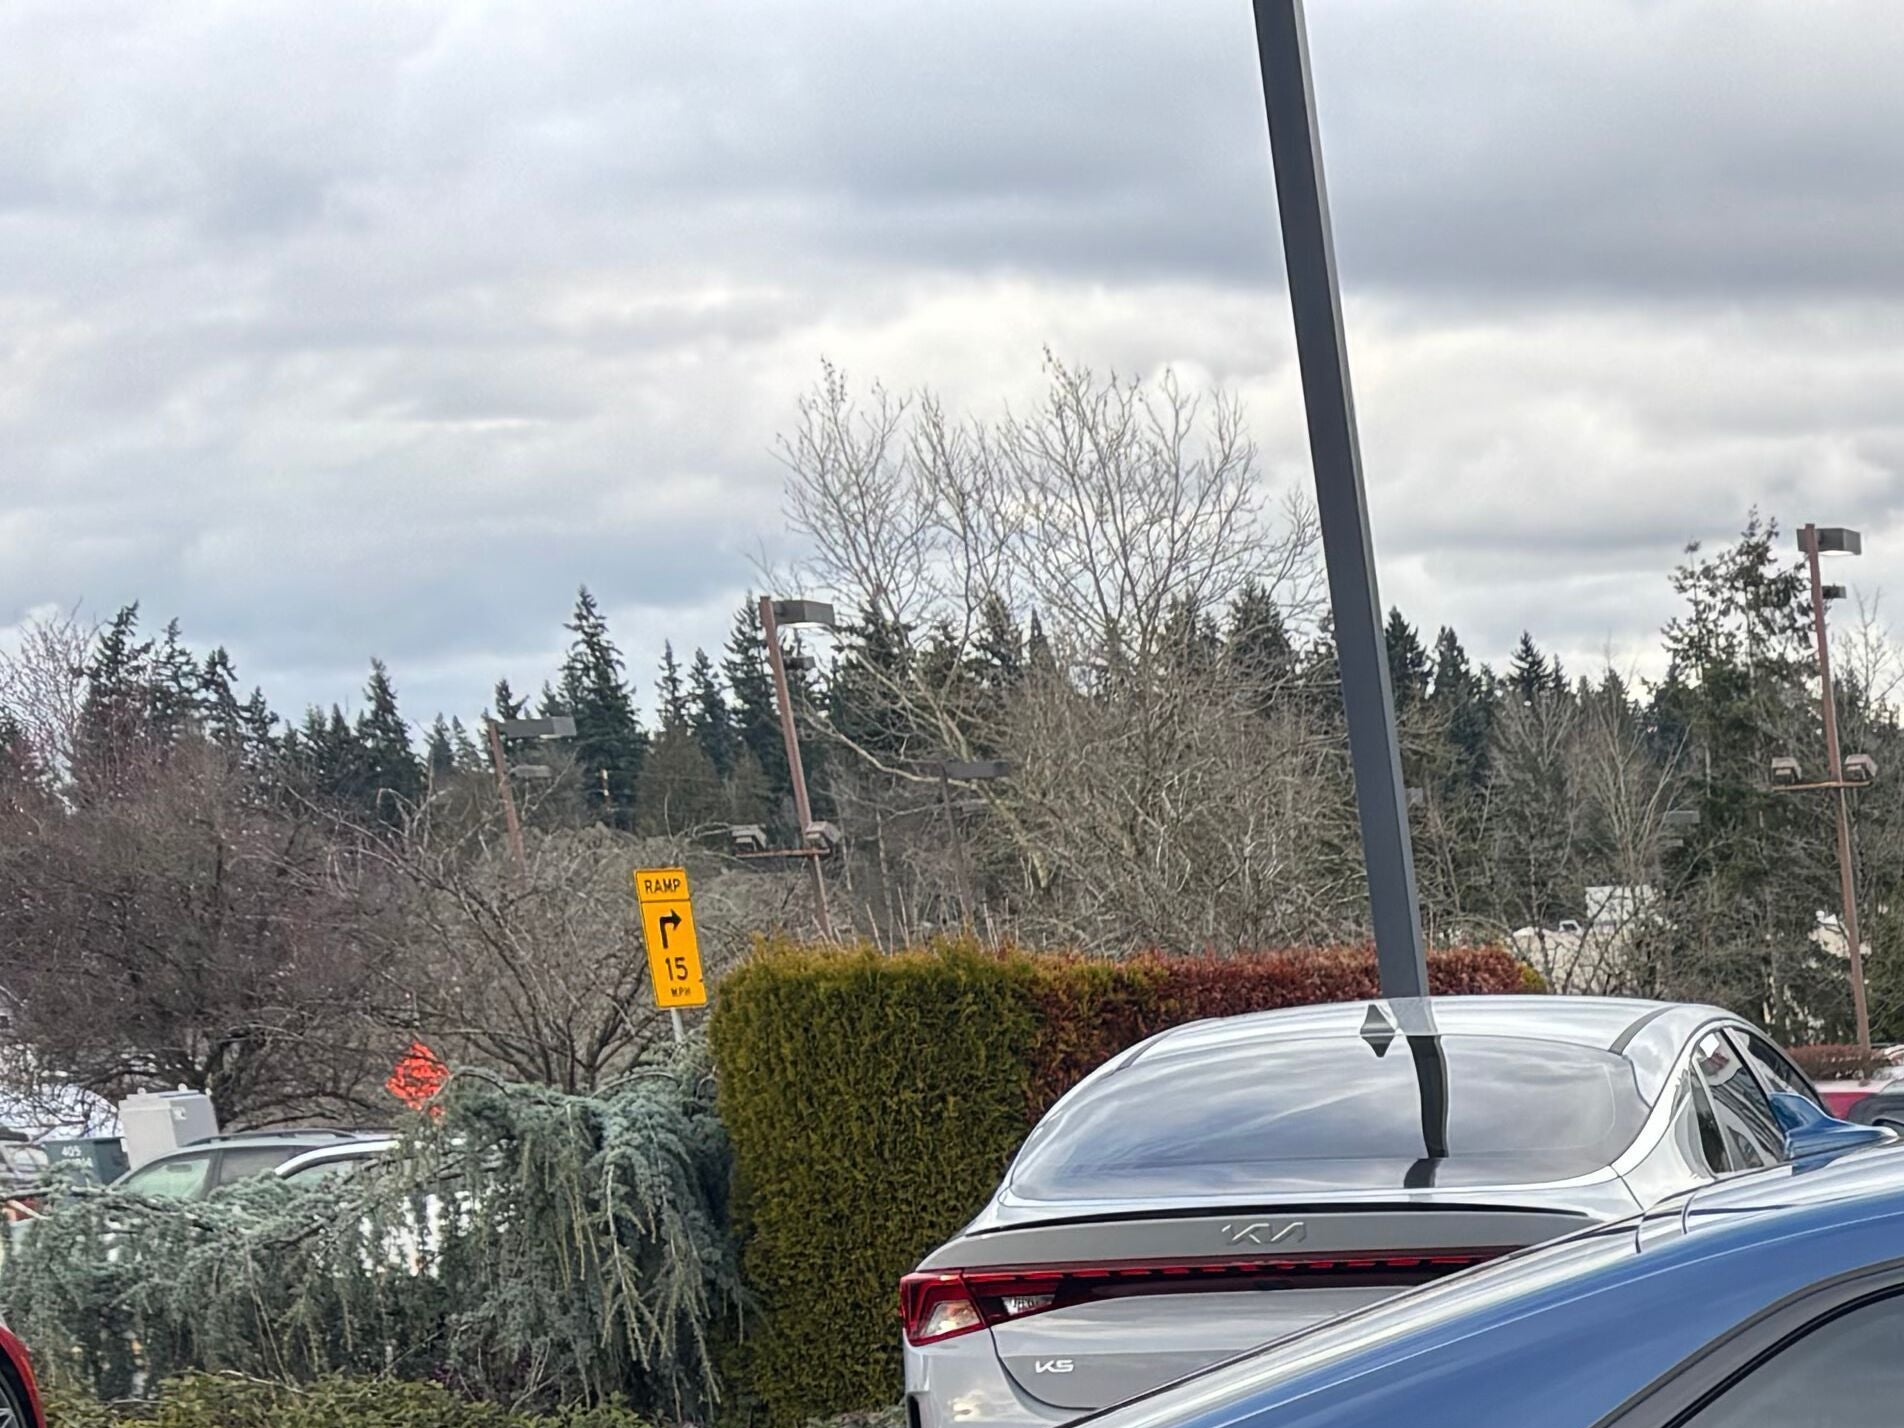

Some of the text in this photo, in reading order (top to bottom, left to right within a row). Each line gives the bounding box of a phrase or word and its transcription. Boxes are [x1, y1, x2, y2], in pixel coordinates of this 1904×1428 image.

[644, 879, 681, 894] RAMP
[665, 956, 688, 981] 15
[671, 986, 691, 997] MPH
[1035, 1359, 1074, 1373] K5
